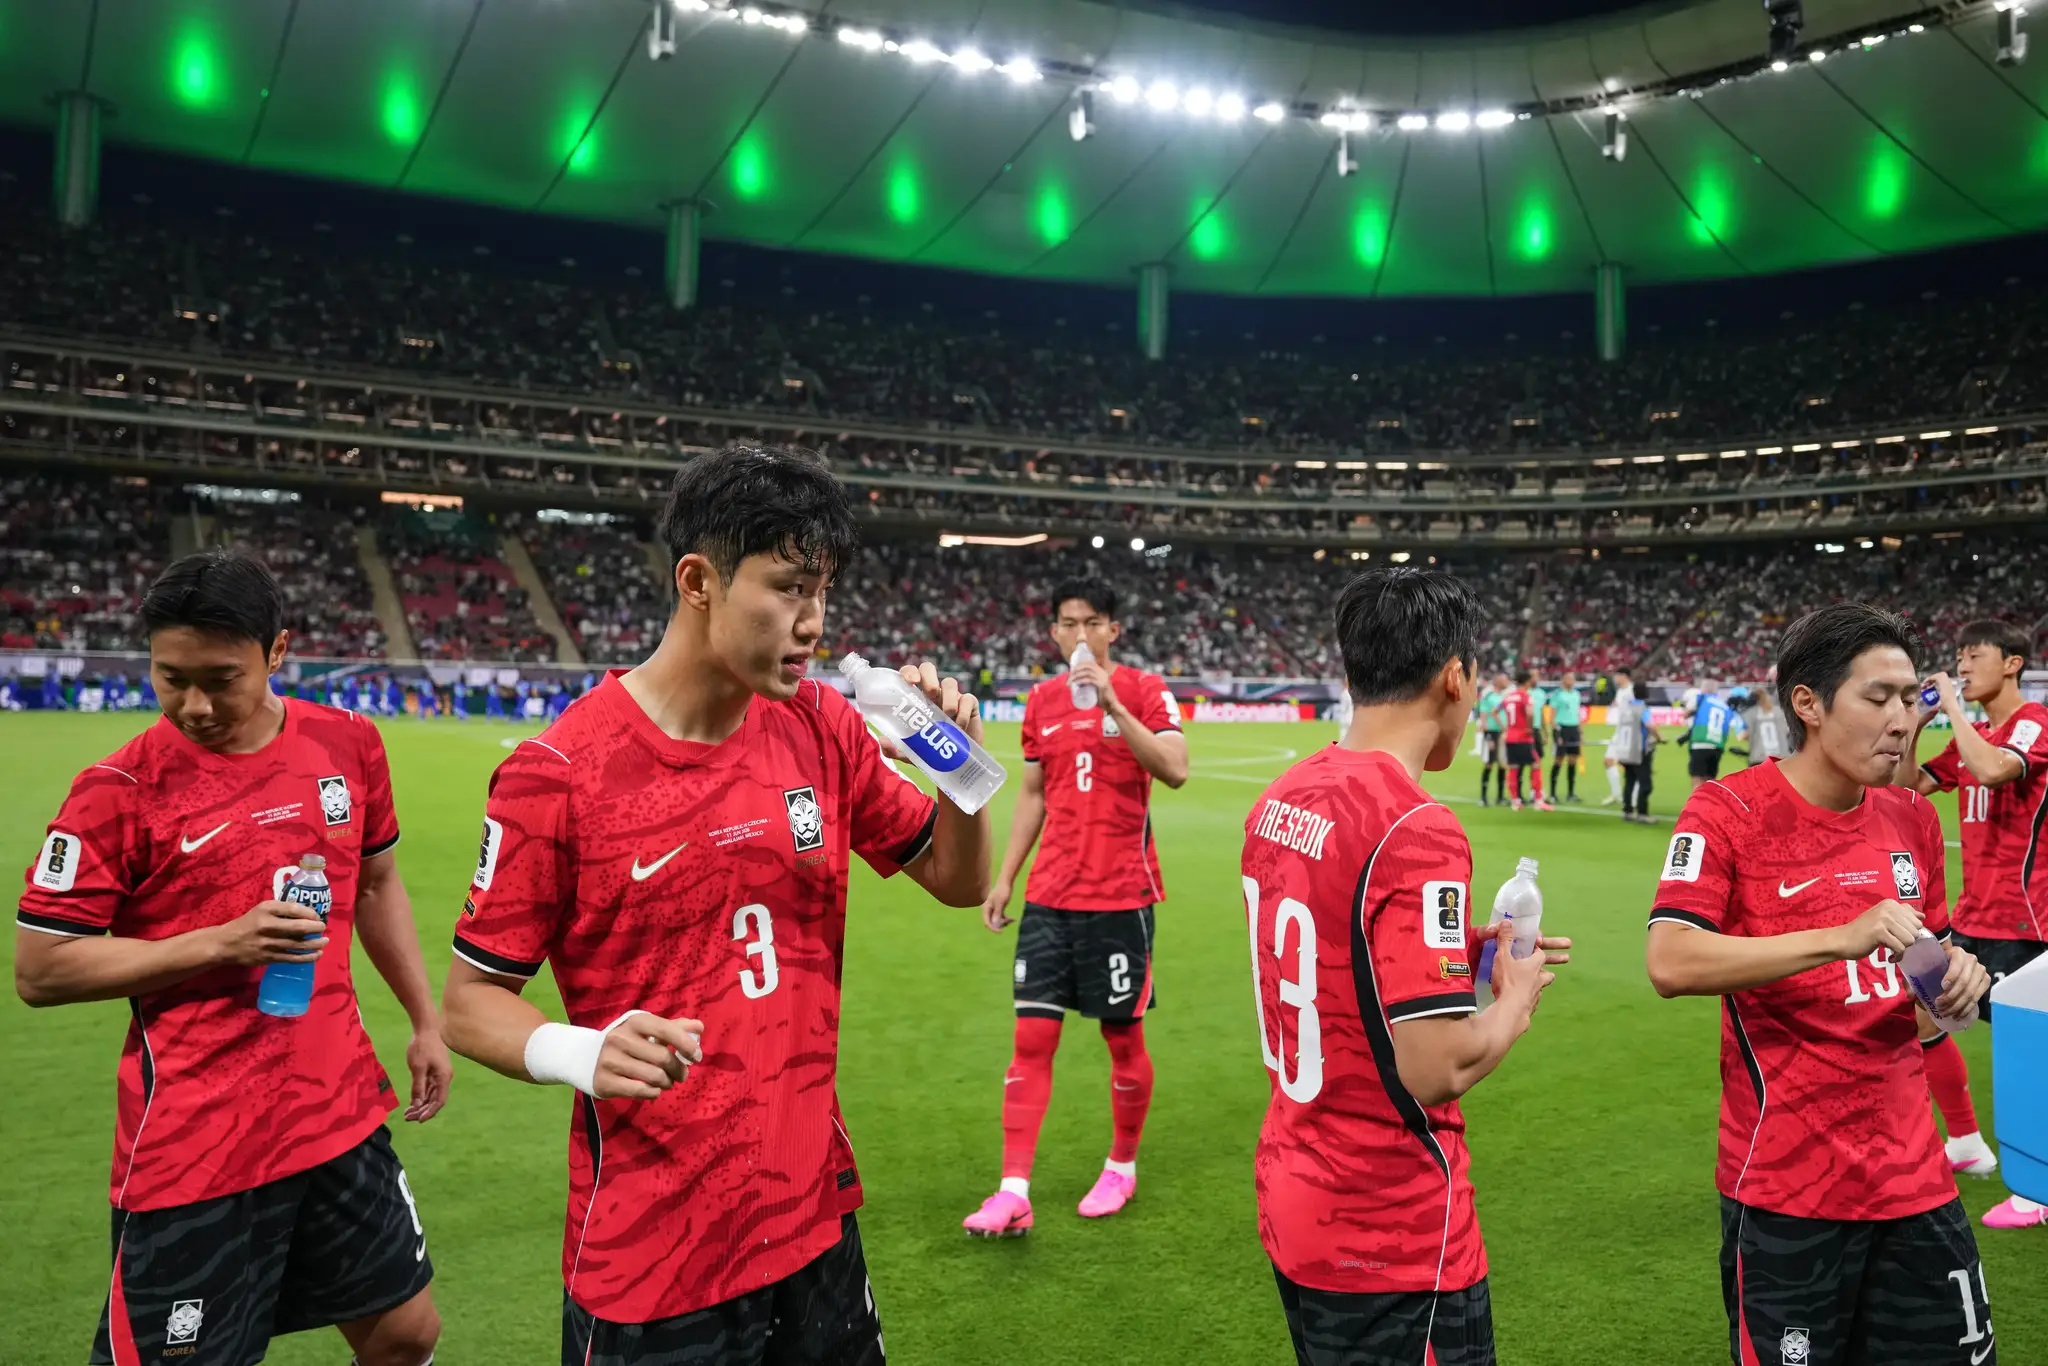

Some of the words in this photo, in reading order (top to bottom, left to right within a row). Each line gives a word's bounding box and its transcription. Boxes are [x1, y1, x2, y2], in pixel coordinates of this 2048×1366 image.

[892, 697, 958, 760] smart
[1076, 752, 1093, 792] 2
[1963, 785, 1988, 823] 10
[326, 828, 352, 839] KOREA
[708, 829, 723, 837] KOREA
[723, 824, 744, 834] REPUBLIC
[747, 818, 768, 827] CZECHIA
[745, 830, 764, 840] MEXICO
[1254, 799, 1336, 860] TAESEOK
[732, 904, 779, 999] 3
[1109, 953, 1131, 993] 2
[1242, 875, 1325, 1104] 13
[1845, 948, 1899, 1006] 19
[1340, 1260, 1388, 1269] AERO-FIT
[1948, 1260, 1993, 1347] 1
[162, 1345, 196, 1357] KOREA
